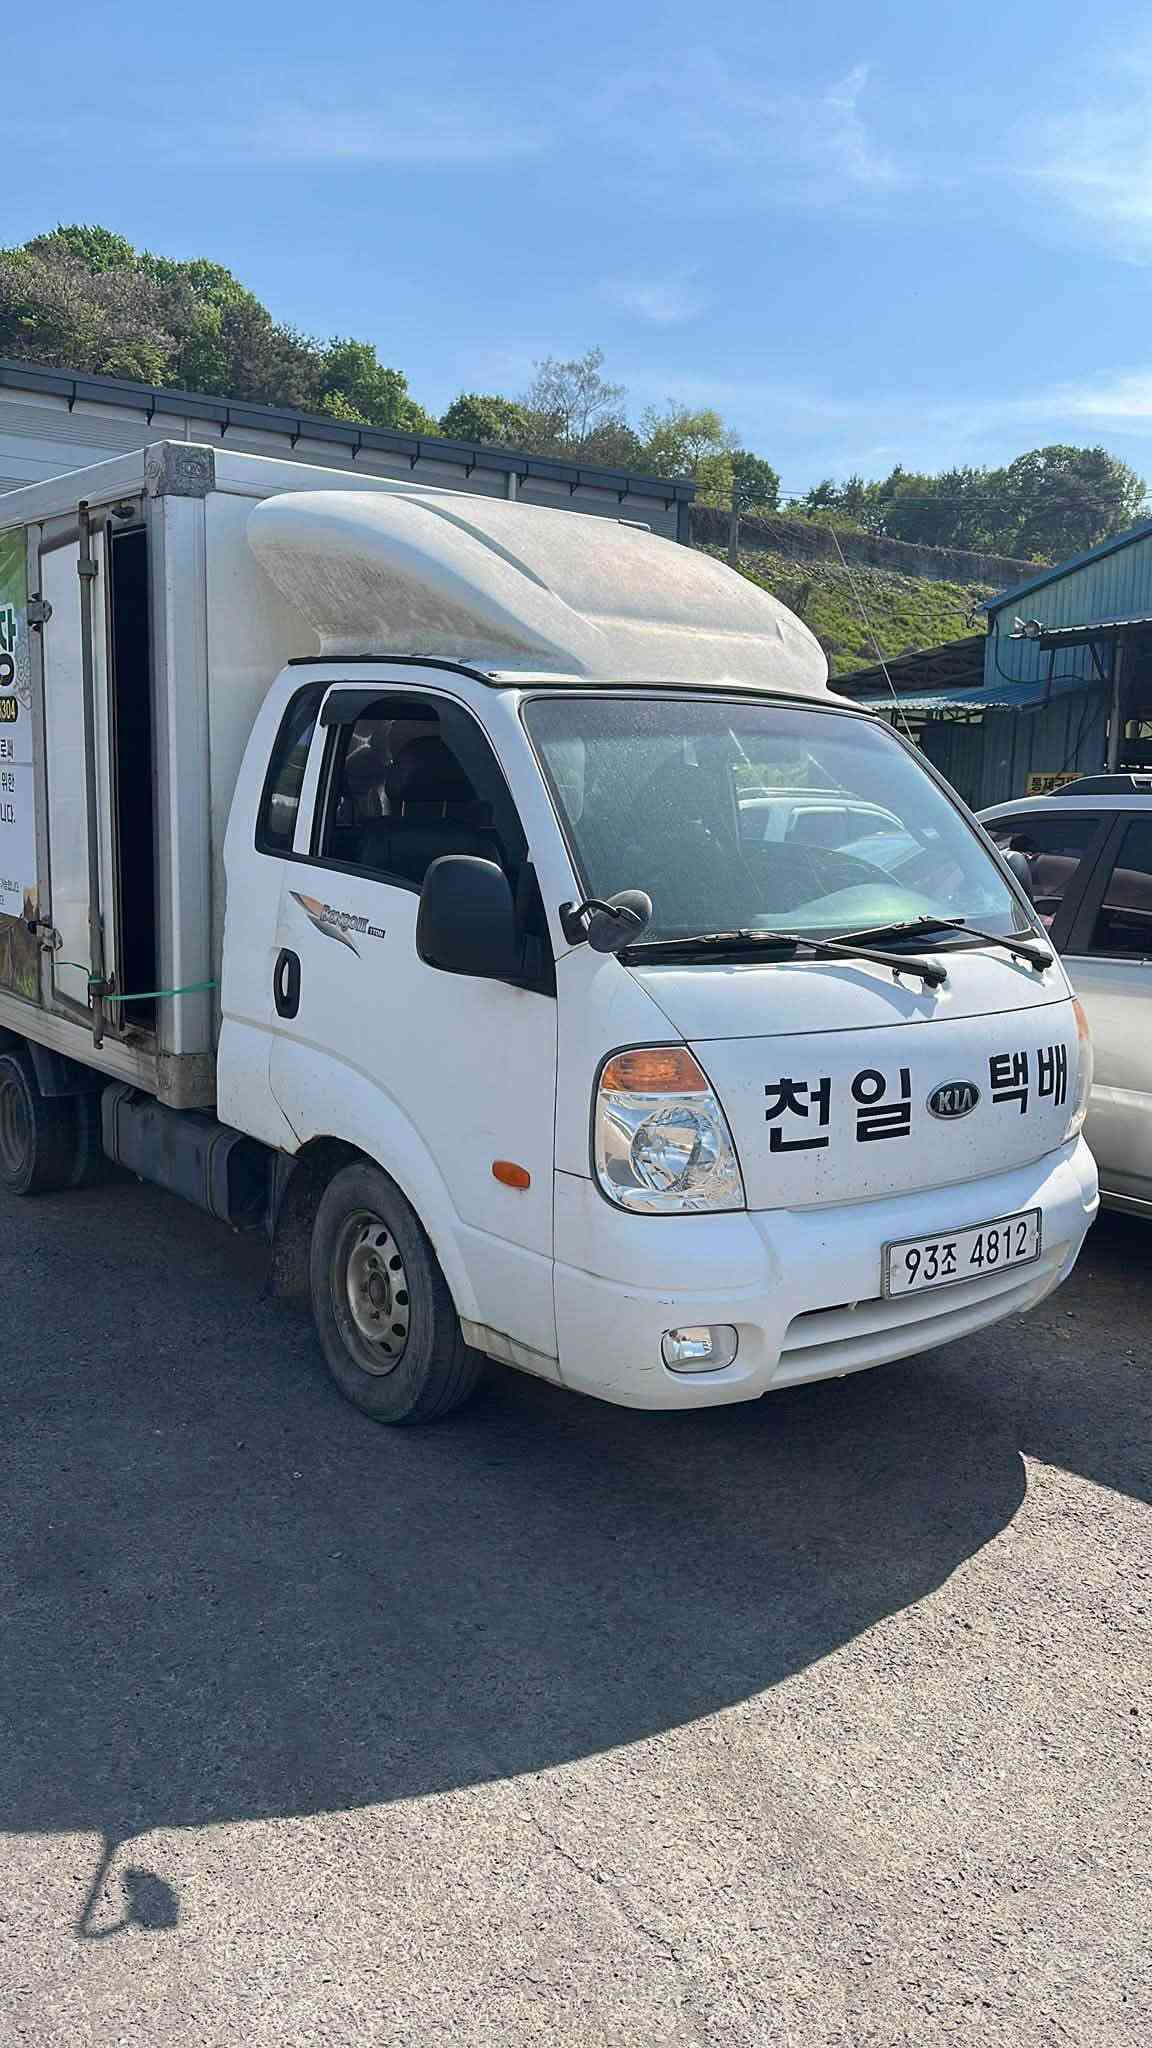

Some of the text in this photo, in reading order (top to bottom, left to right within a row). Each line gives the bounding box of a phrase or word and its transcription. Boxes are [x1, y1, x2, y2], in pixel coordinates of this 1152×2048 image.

[0, 698, 16, 719] 304
[764, 1044, 1067, 1153] 천일 택배
[936, 1087, 975, 1113] KIA
[905, 1221, 1027, 1285] 93조 4812
